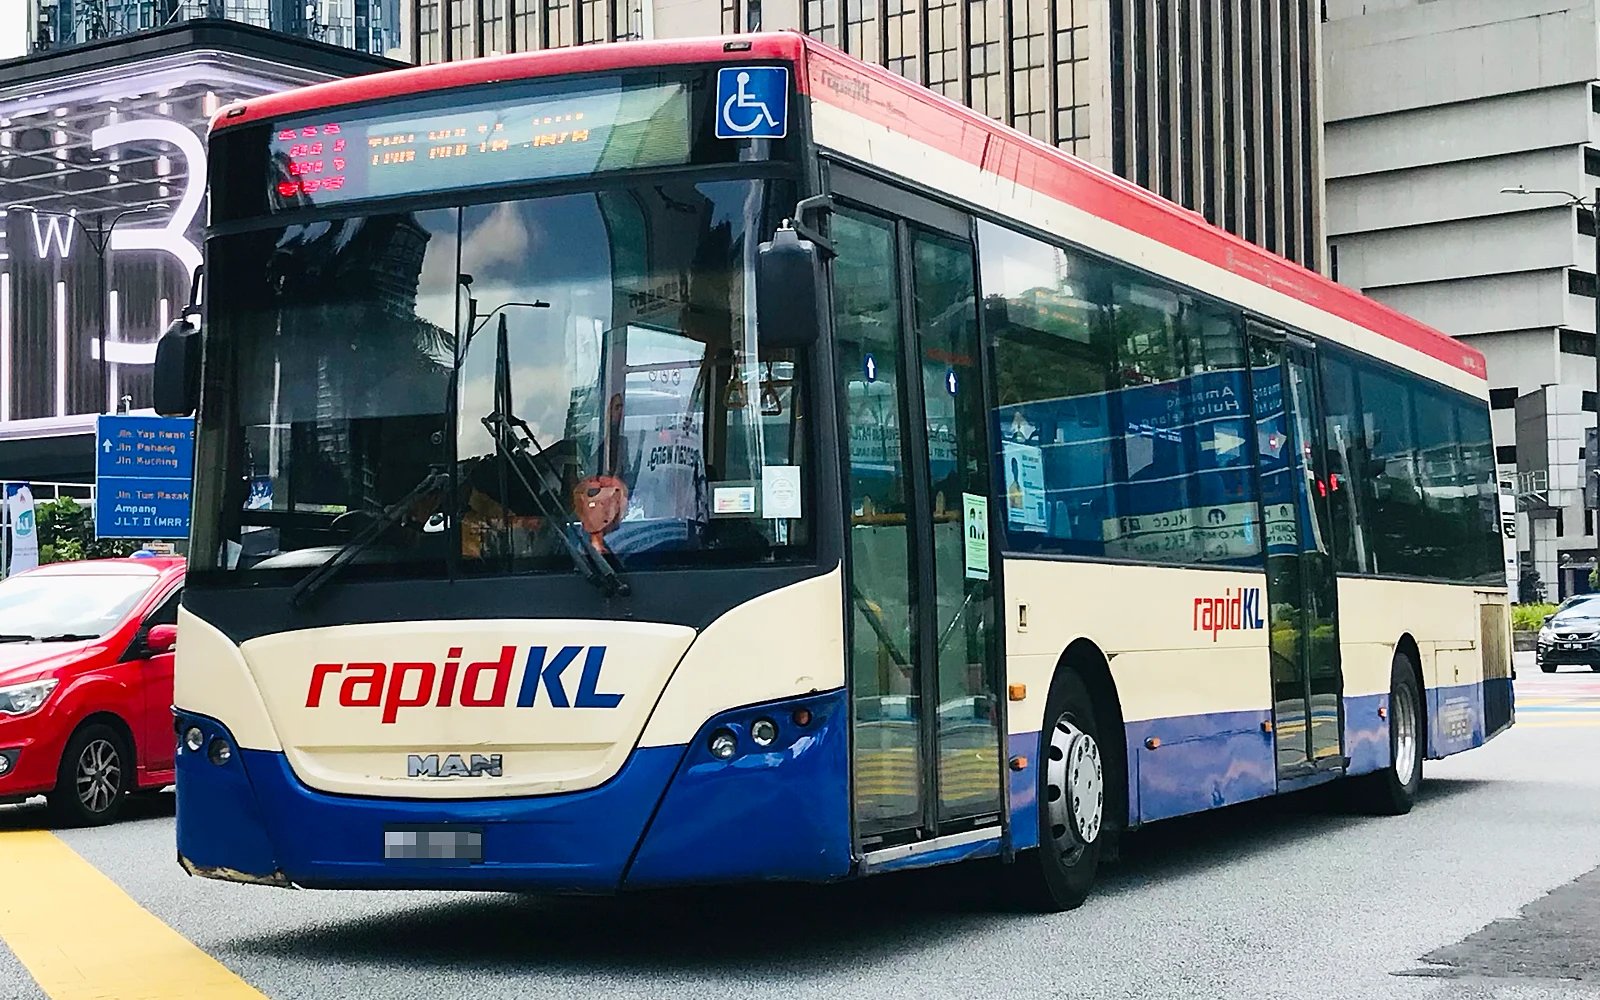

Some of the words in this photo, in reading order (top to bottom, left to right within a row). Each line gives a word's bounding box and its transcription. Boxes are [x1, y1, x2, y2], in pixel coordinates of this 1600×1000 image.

[136, 429, 155, 440] Yap
[136, 442, 176, 454] Pahang
[136, 456, 178, 469] Kuching
[114, 504, 157, 516] Ampang
[154, 516, 182, 527] (MRR
[1193, 587, 1265, 643] rapidKL
[305, 645, 626, 724] rapidKL
[407, 753, 503, 778] MAN
